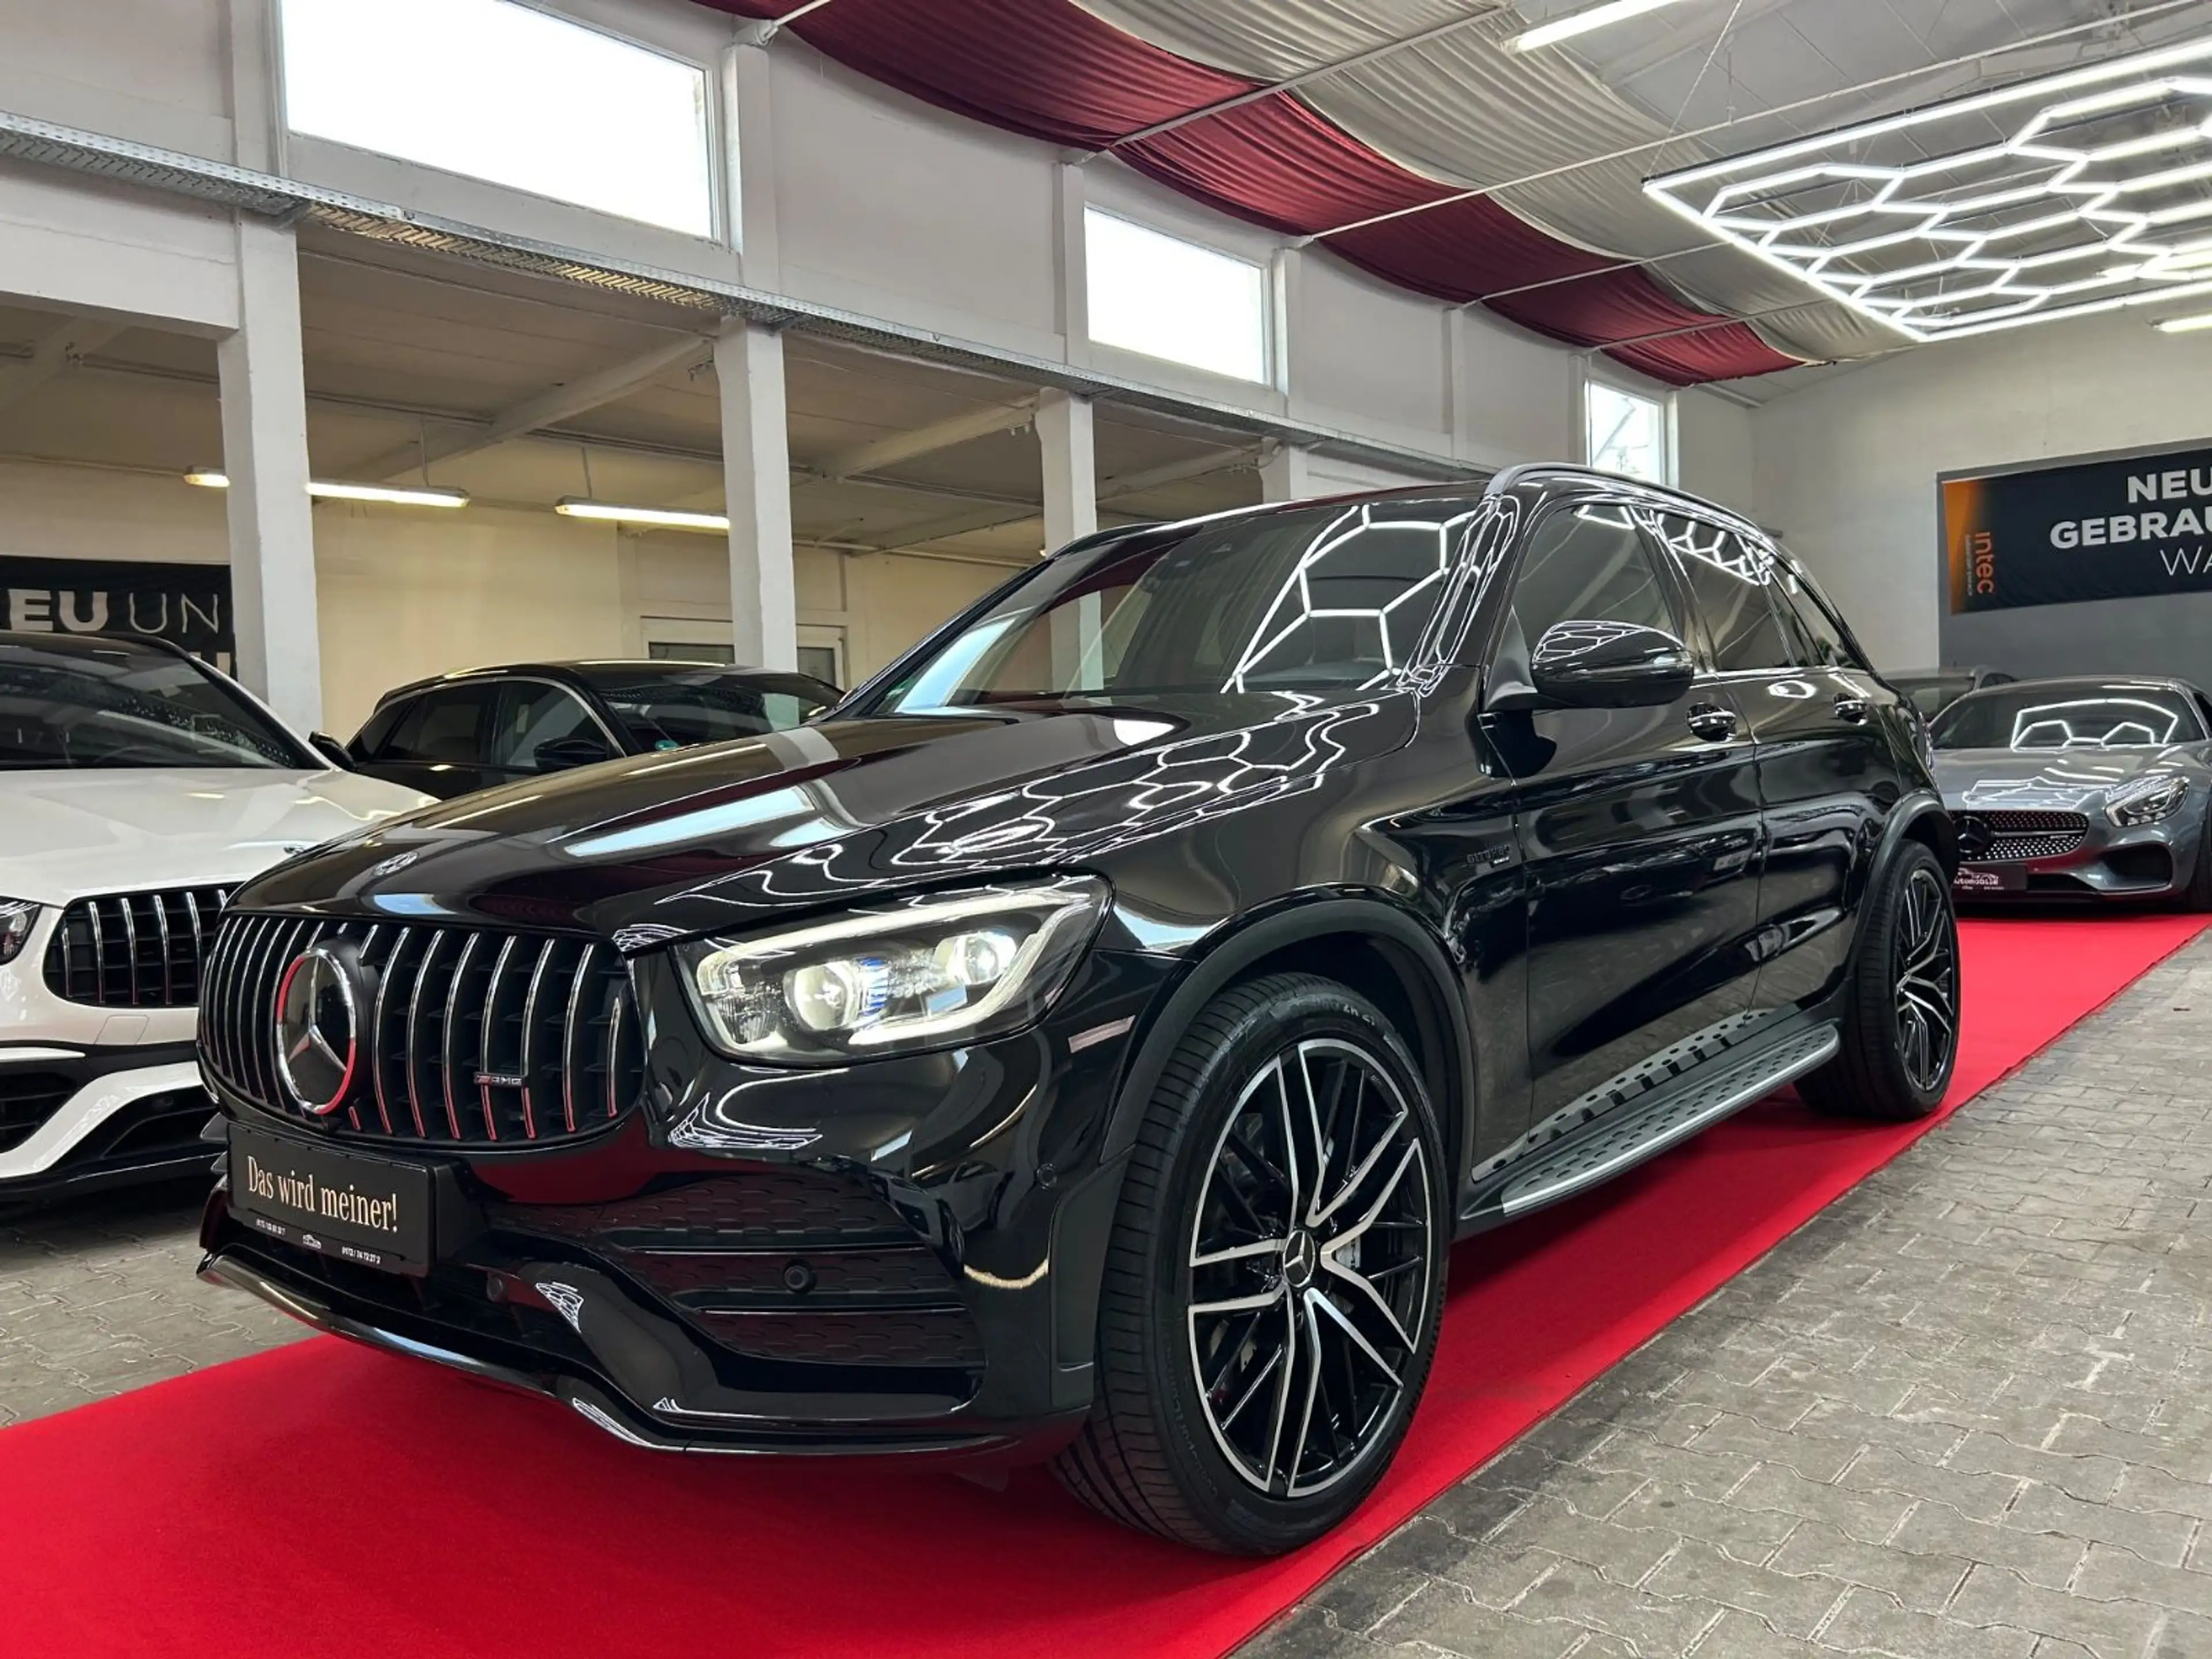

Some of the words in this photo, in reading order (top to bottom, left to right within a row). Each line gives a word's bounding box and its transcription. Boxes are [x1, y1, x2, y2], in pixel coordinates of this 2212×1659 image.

[2127, 467, 2212, 503] NEU
[1974, 531, 1995, 594] intec
[0, 589, 109, 632] EU
[491, 1076, 522, 1086] AMG
[247, 1156, 274, 1199] Das
[277, 1169, 316, 1212] wird
[320, 1184, 398, 1233] meiner!
